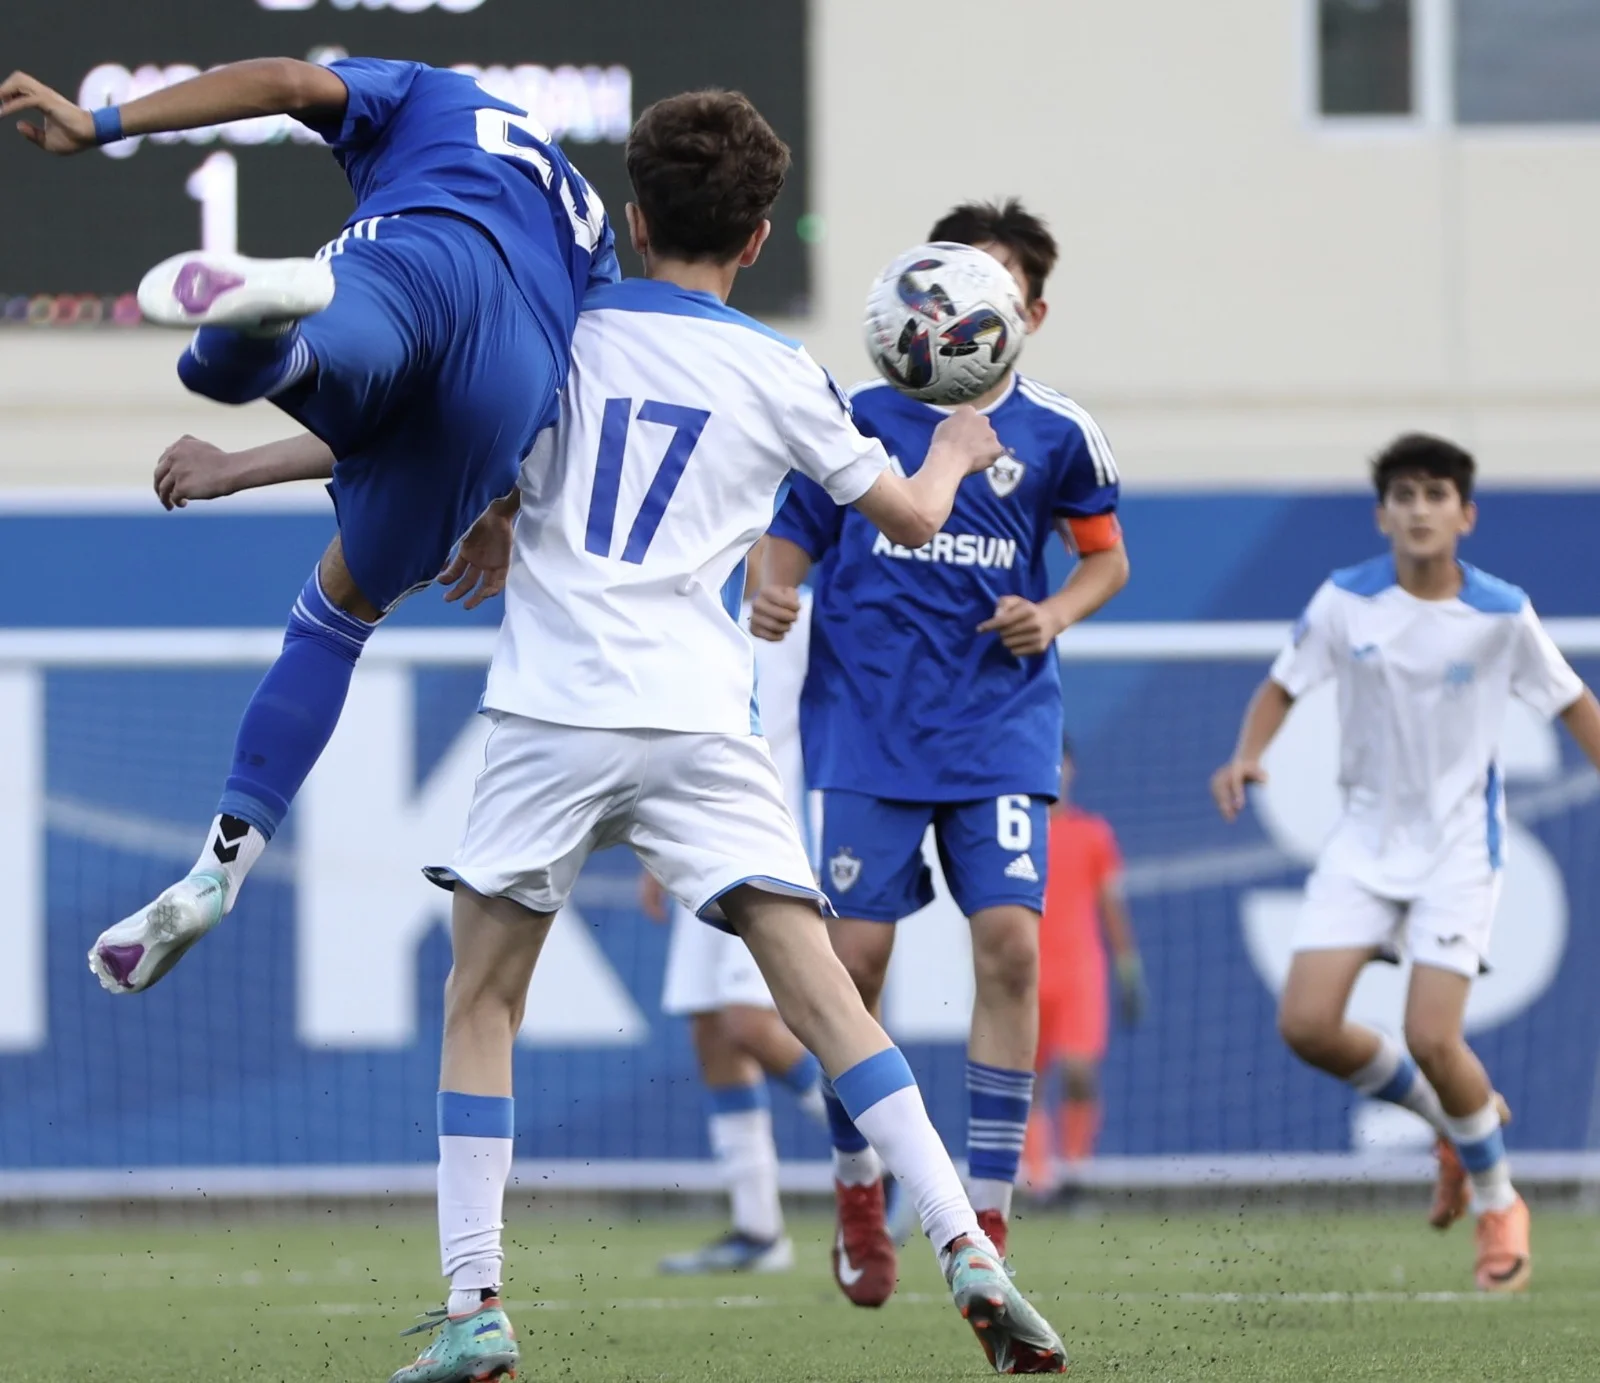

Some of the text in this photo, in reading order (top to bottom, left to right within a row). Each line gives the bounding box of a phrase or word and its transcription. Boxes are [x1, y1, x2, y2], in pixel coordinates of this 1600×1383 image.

[186, 152, 238, 253] 1
[584, 397, 712, 565] 17
[996, 794, 1033, 851] 6
